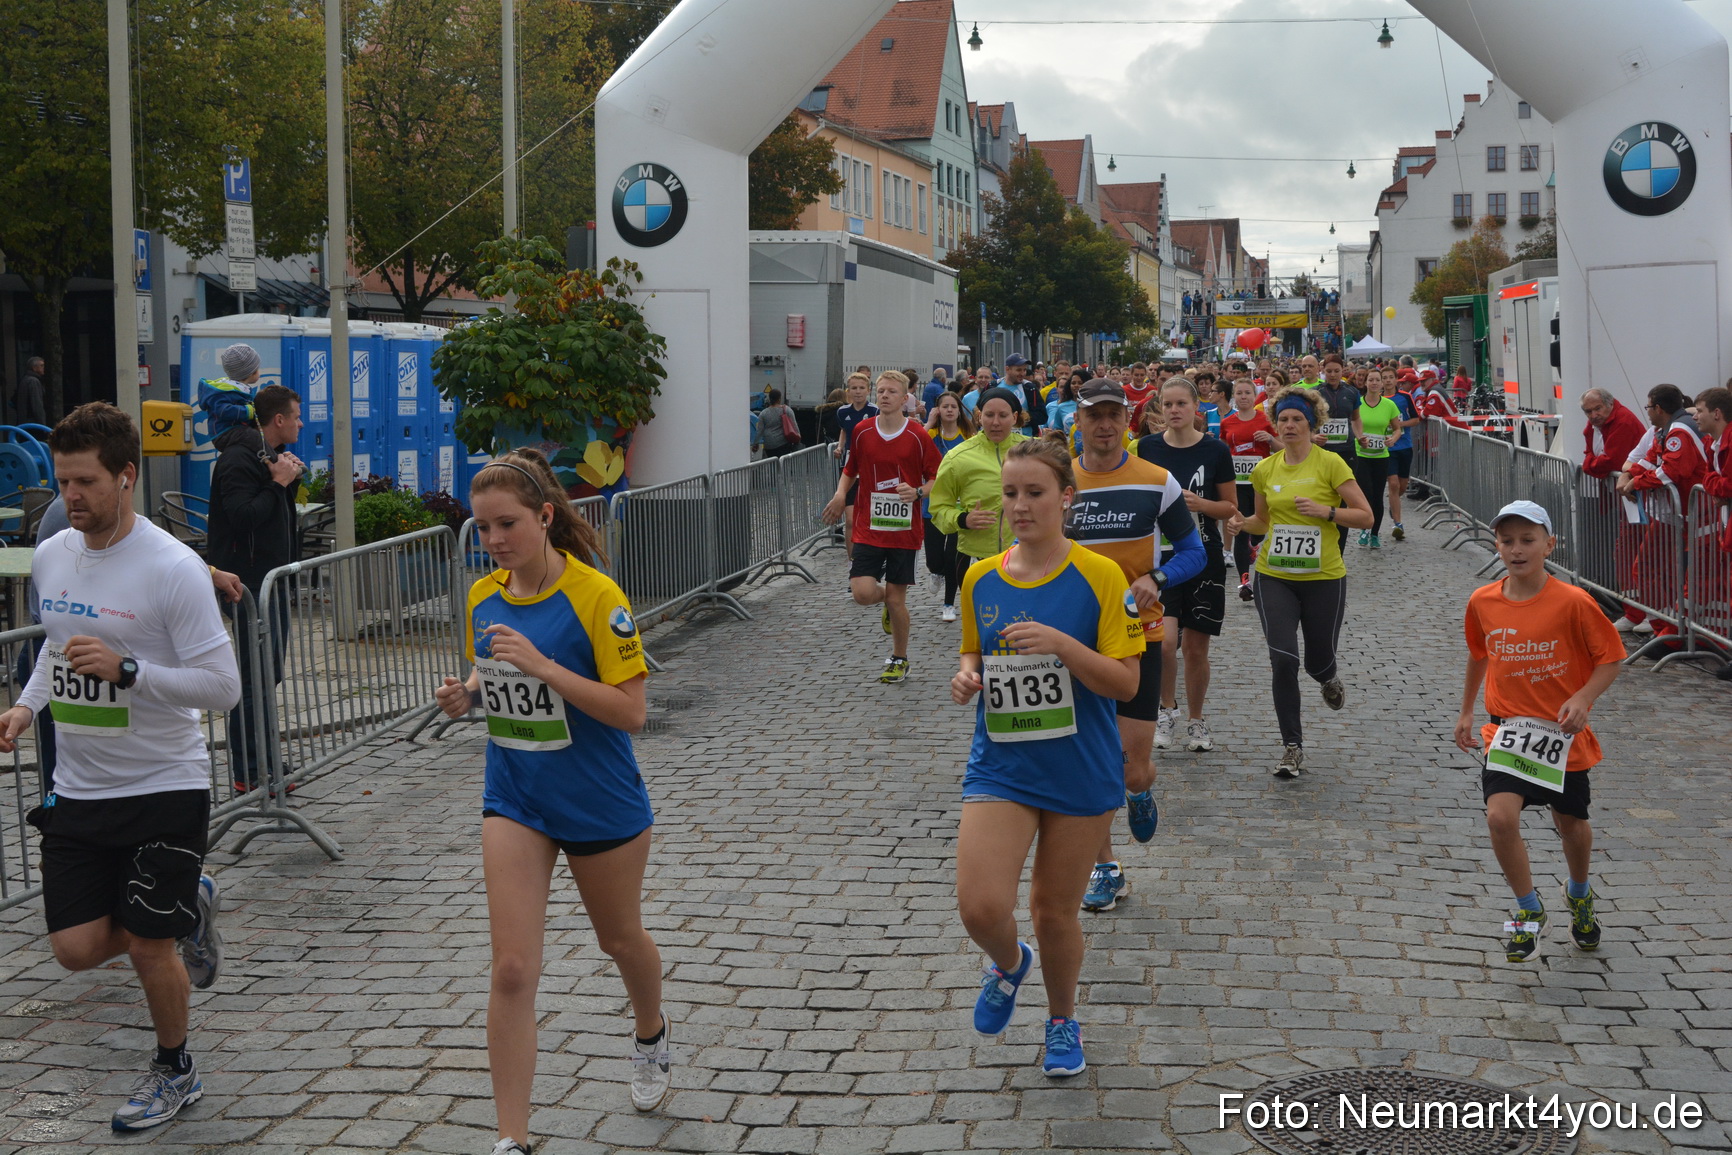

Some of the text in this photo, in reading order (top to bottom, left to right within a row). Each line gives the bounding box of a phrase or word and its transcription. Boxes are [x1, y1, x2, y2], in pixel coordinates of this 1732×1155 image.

[1610, 124, 1689, 156] BMW
[617, 164, 682, 193] BMW
[228, 216, 252, 226] Parkschein
[231, 226, 251, 236] werktags
[172, 315, 181, 334] 3
[1245, 317, 1278, 326] START
[1322, 424, 1346, 434] 5217
[1234, 462, 1258, 474] 502
[874, 501, 909, 518] 5006
[1073, 510, 1136, 525] Fischer
[1079, 522, 1131, 531] AUTOMOBILE
[1274, 536, 1316, 556] 5173
[1280, 558, 1306, 568] Brigitte
[100, 607, 136, 620] energie
[1495, 640, 1558, 654] Fischer
[49, 650, 69, 661] PARTL
[1501, 652, 1554, 662] AUTOMOBILE
[1006, 661, 1051, 673] Neumarkt
[53, 665, 117, 703] 5501
[989, 673, 1063, 709] 5133
[483, 680, 555, 717] 5134
[1011, 716, 1042, 729] Anna
[1525, 721, 1561, 737] Neumarkt
[510, 723, 535, 738] Lena
[1499, 730, 1564, 765] 5148
[1514, 759, 1538, 776] Chris
